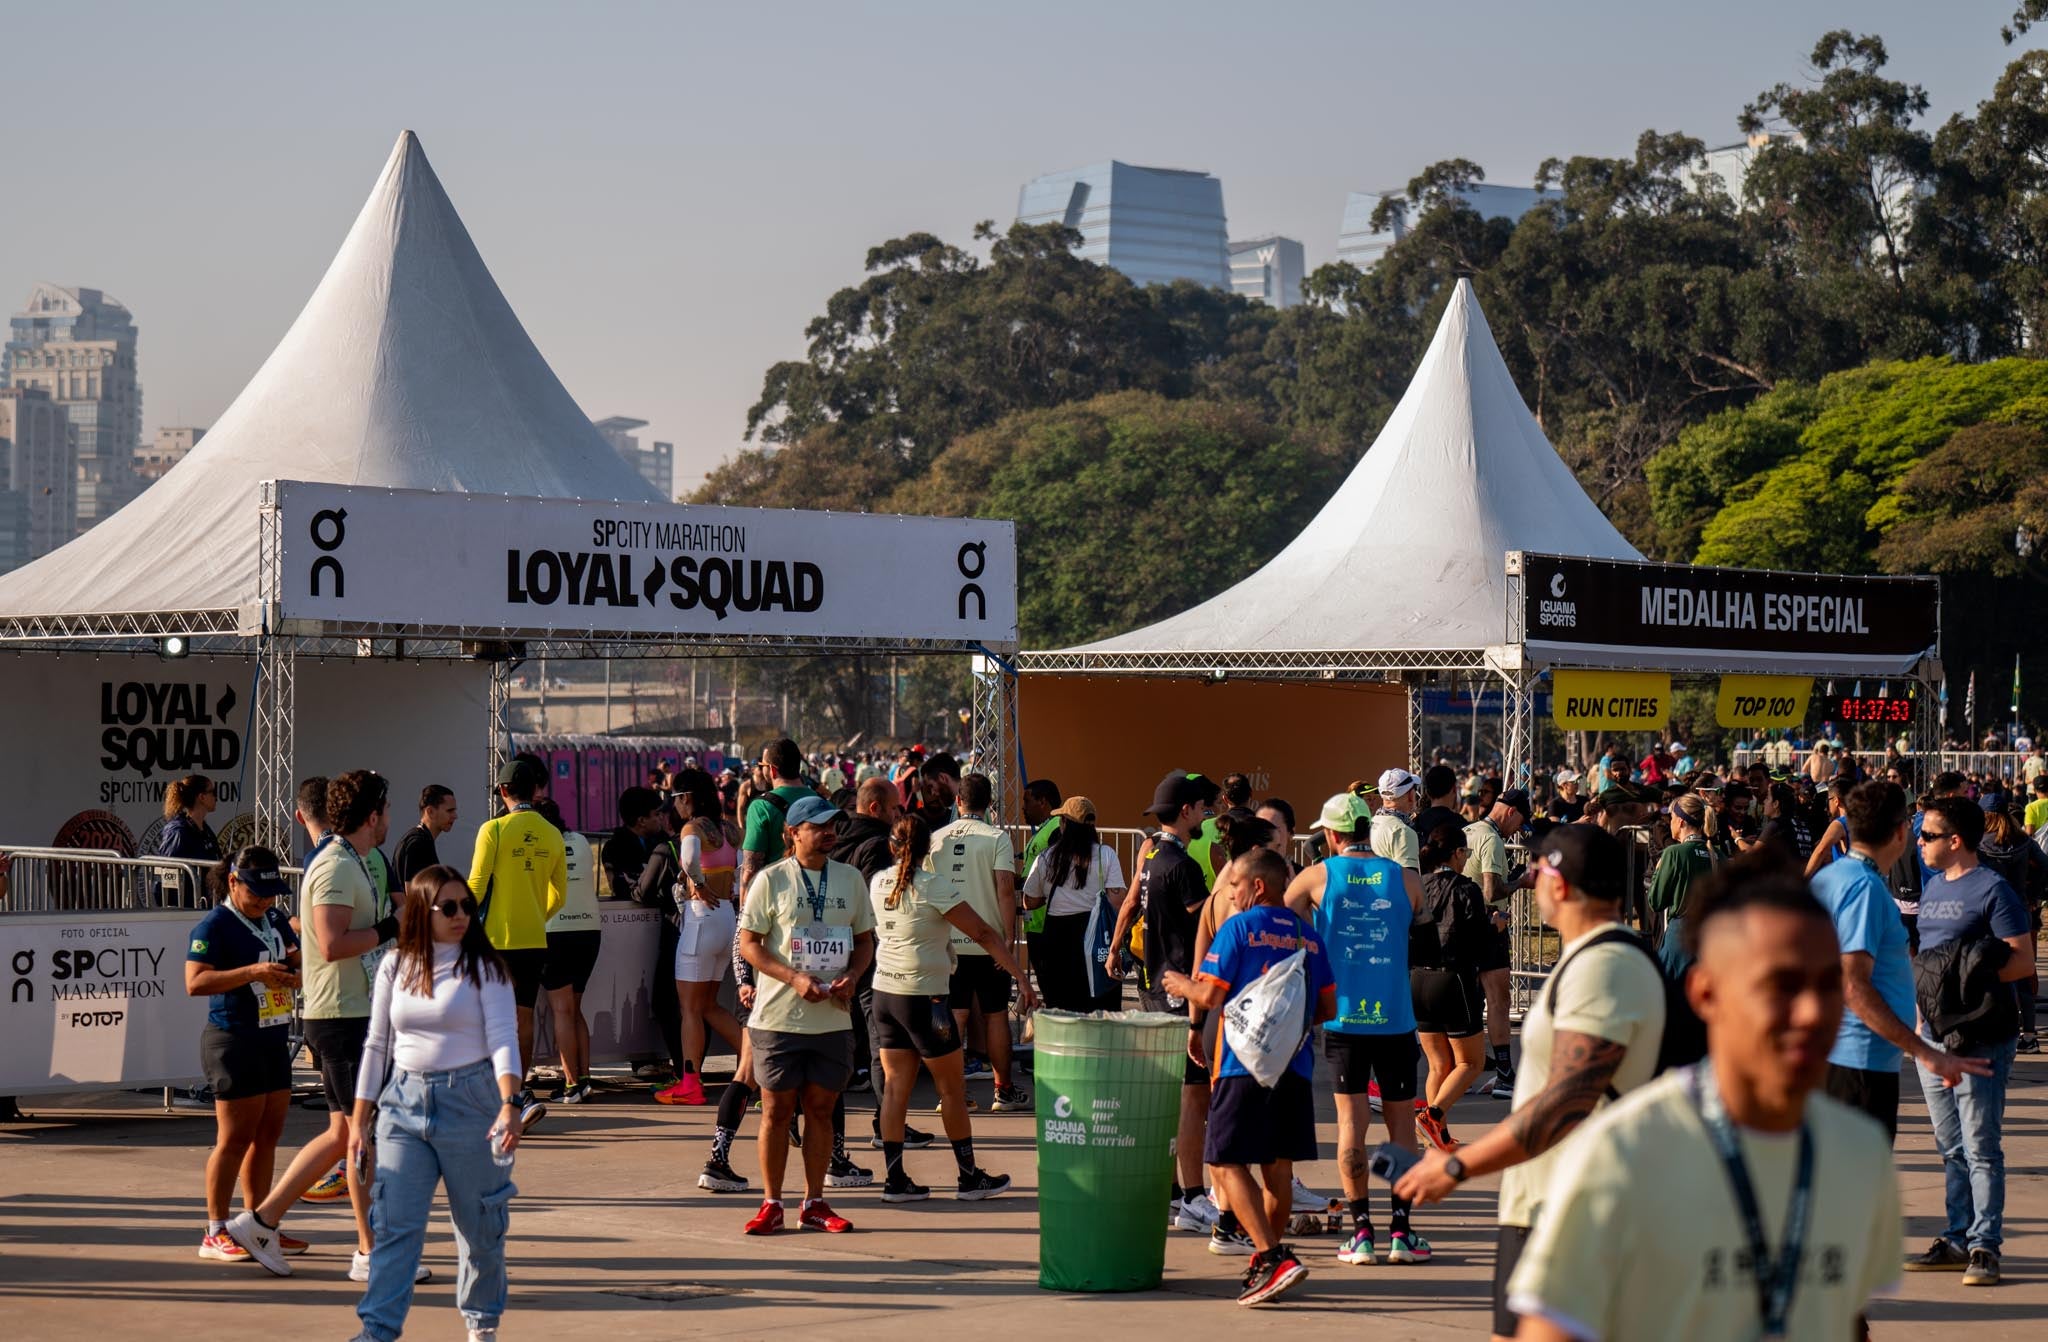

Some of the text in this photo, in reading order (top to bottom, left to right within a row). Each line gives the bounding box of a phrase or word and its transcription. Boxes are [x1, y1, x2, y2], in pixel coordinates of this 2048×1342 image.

[593, 519, 745, 553] SPCITY MARATHON
[507, 549, 824, 621] LOYAL SQUAD
[1540, 600, 1576, 615] IGUANA
[1641, 586, 1869, 634] MEDALHA ESPECIAL
[1540, 613, 1576, 627] SPORTS
[101, 681, 212, 726] LOYAL
[1566, 697, 1658, 718] RUN CITIES
[1733, 696, 1795, 717] TOP 100
[100, 727, 240, 780] SQUAD
[1920, 901, 1964, 919] GUESS
[61, 928, 130, 939] FOTO OFICIAL
[806, 941, 843, 955] 10741
[51, 947, 165, 980] SPCITY
[51, 980, 165, 1001] MARATHON
[72, 1011, 124, 1028] FOTOP
[1092, 1097, 1121, 1109] mais
[1092, 1112, 1114, 1124] que
[1045, 1120, 1086, 1134] IGUANA
[1092, 1124, 1118, 1135] uma
[1045, 1131, 1086, 1146] SPORTS
[1092, 1134, 1136, 1147] corrida
